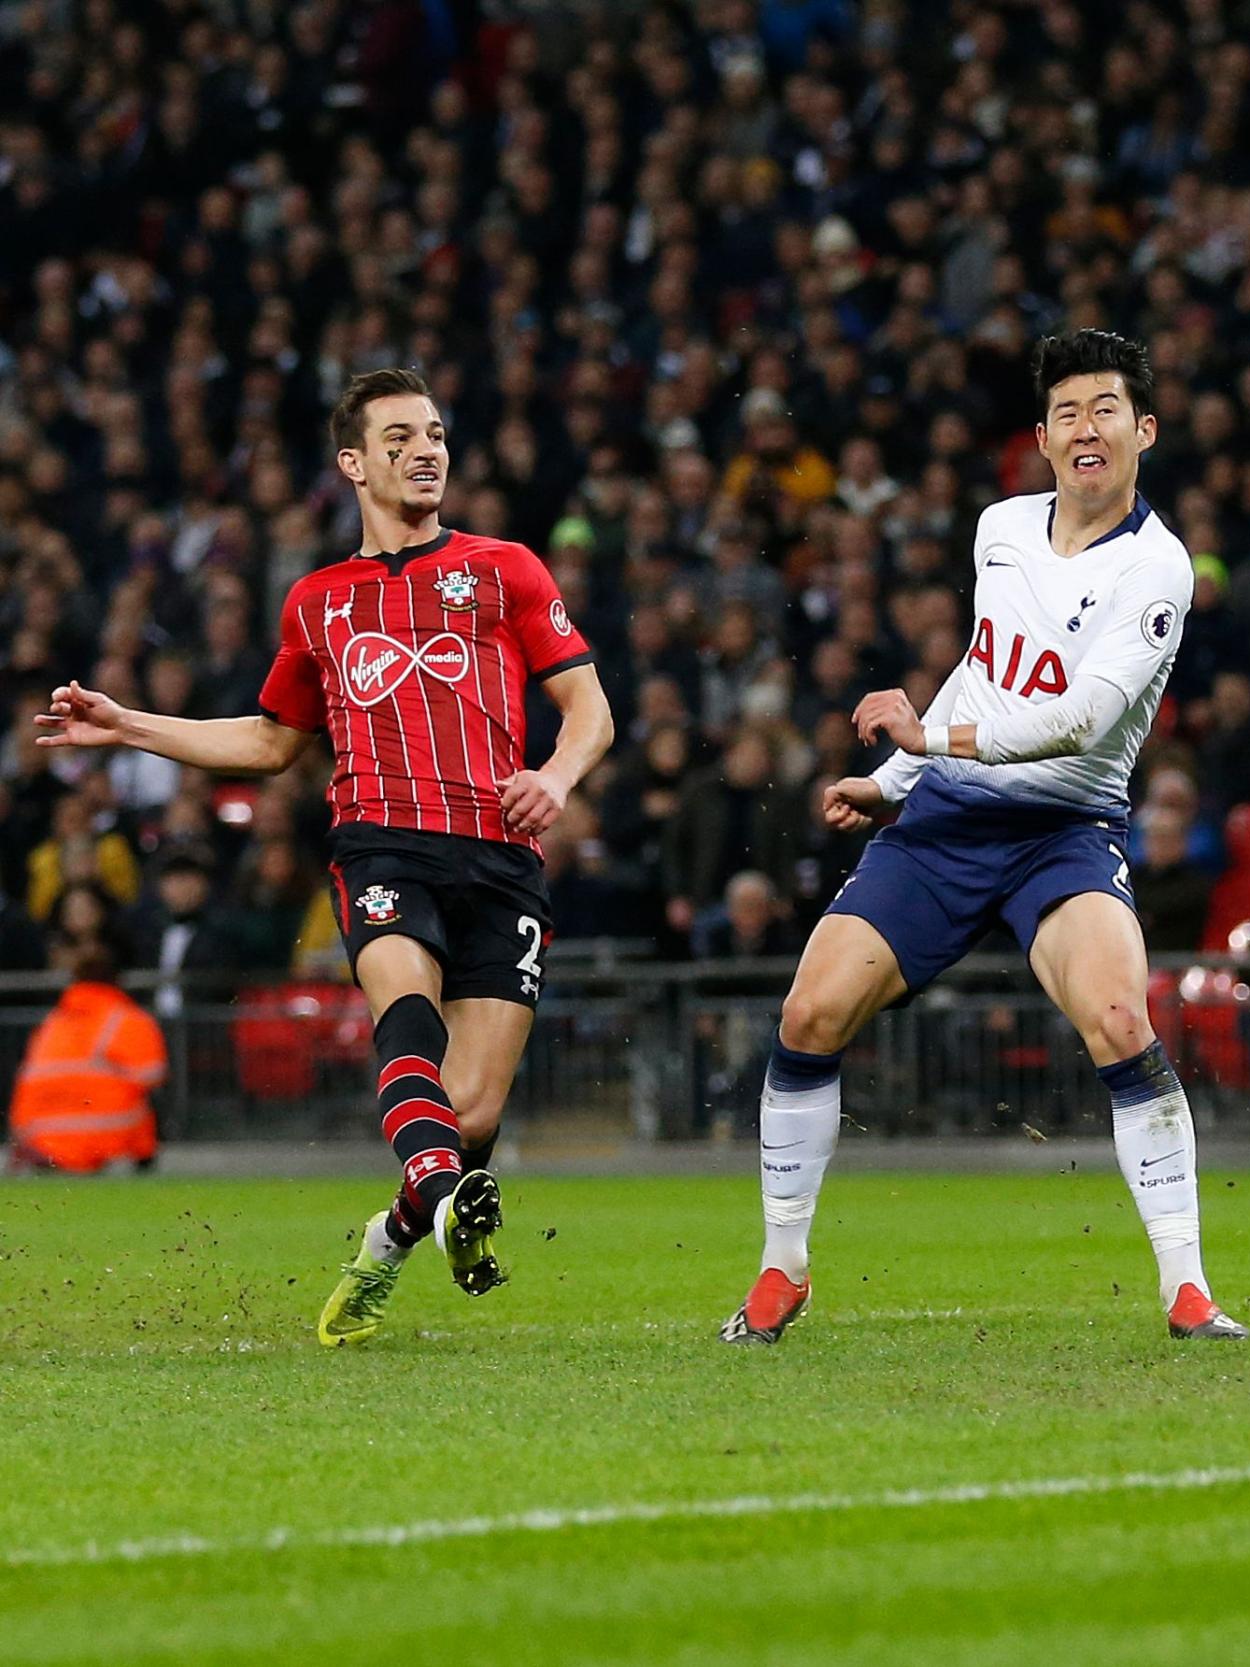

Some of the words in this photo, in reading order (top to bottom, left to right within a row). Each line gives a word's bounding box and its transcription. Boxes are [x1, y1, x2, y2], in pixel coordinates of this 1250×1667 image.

[351, 646, 400, 692] Virgin
[424, 651, 463, 663] media
[967, 617, 1069, 699] AIA
[515, 915, 542, 978] 2
[1146, 1173, 1185, 1189] SPURS
